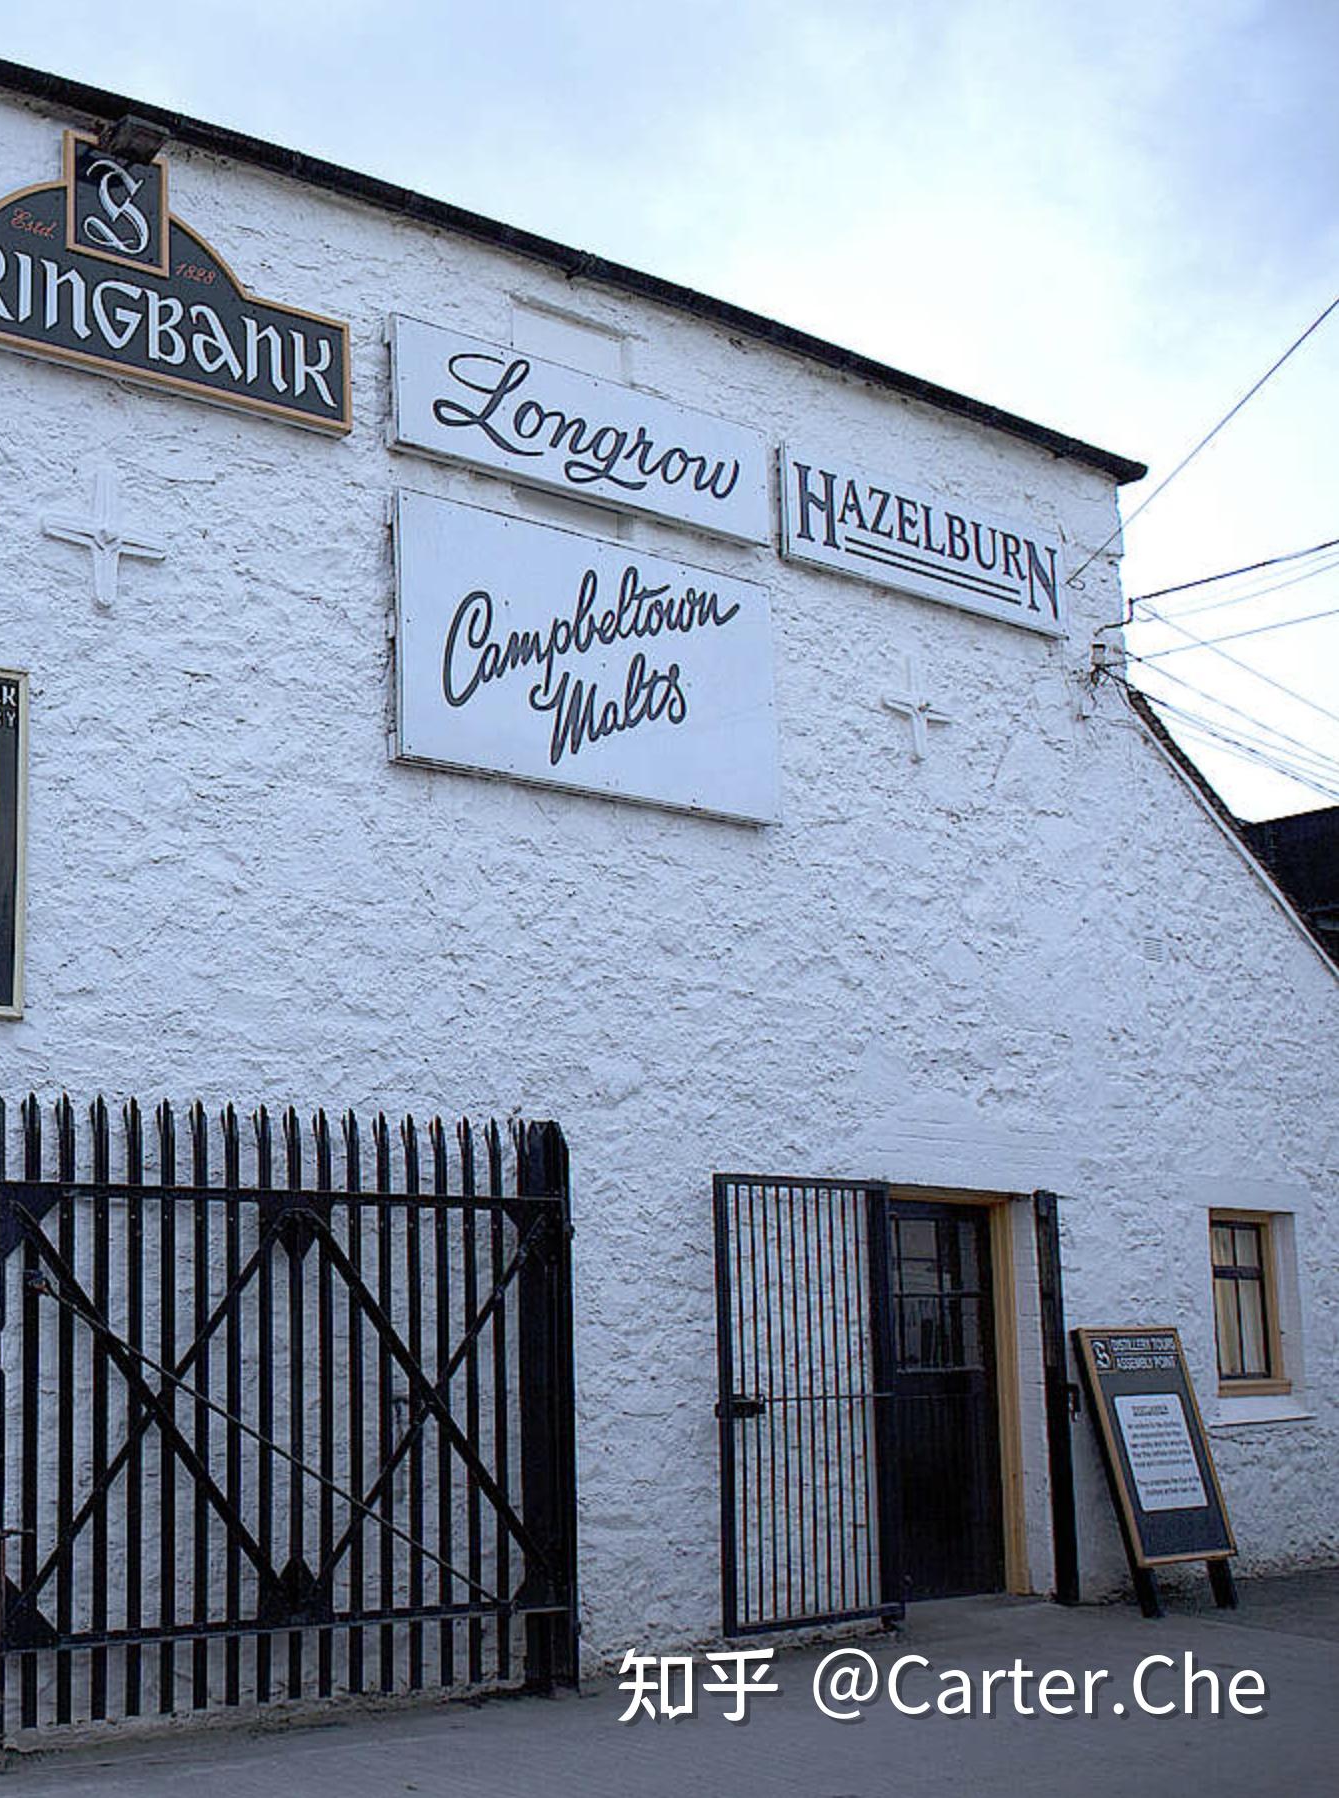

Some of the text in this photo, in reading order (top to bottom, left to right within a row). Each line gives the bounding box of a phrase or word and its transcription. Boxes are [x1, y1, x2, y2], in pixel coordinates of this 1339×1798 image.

[174, 262, 217, 285] 1828
[433, 353, 740, 499] Longrow
[793, 462, 1060, 621] HAZELBURN
[443, 567, 741, 707] Campbeltown
[529, 653, 687, 766] Malts
